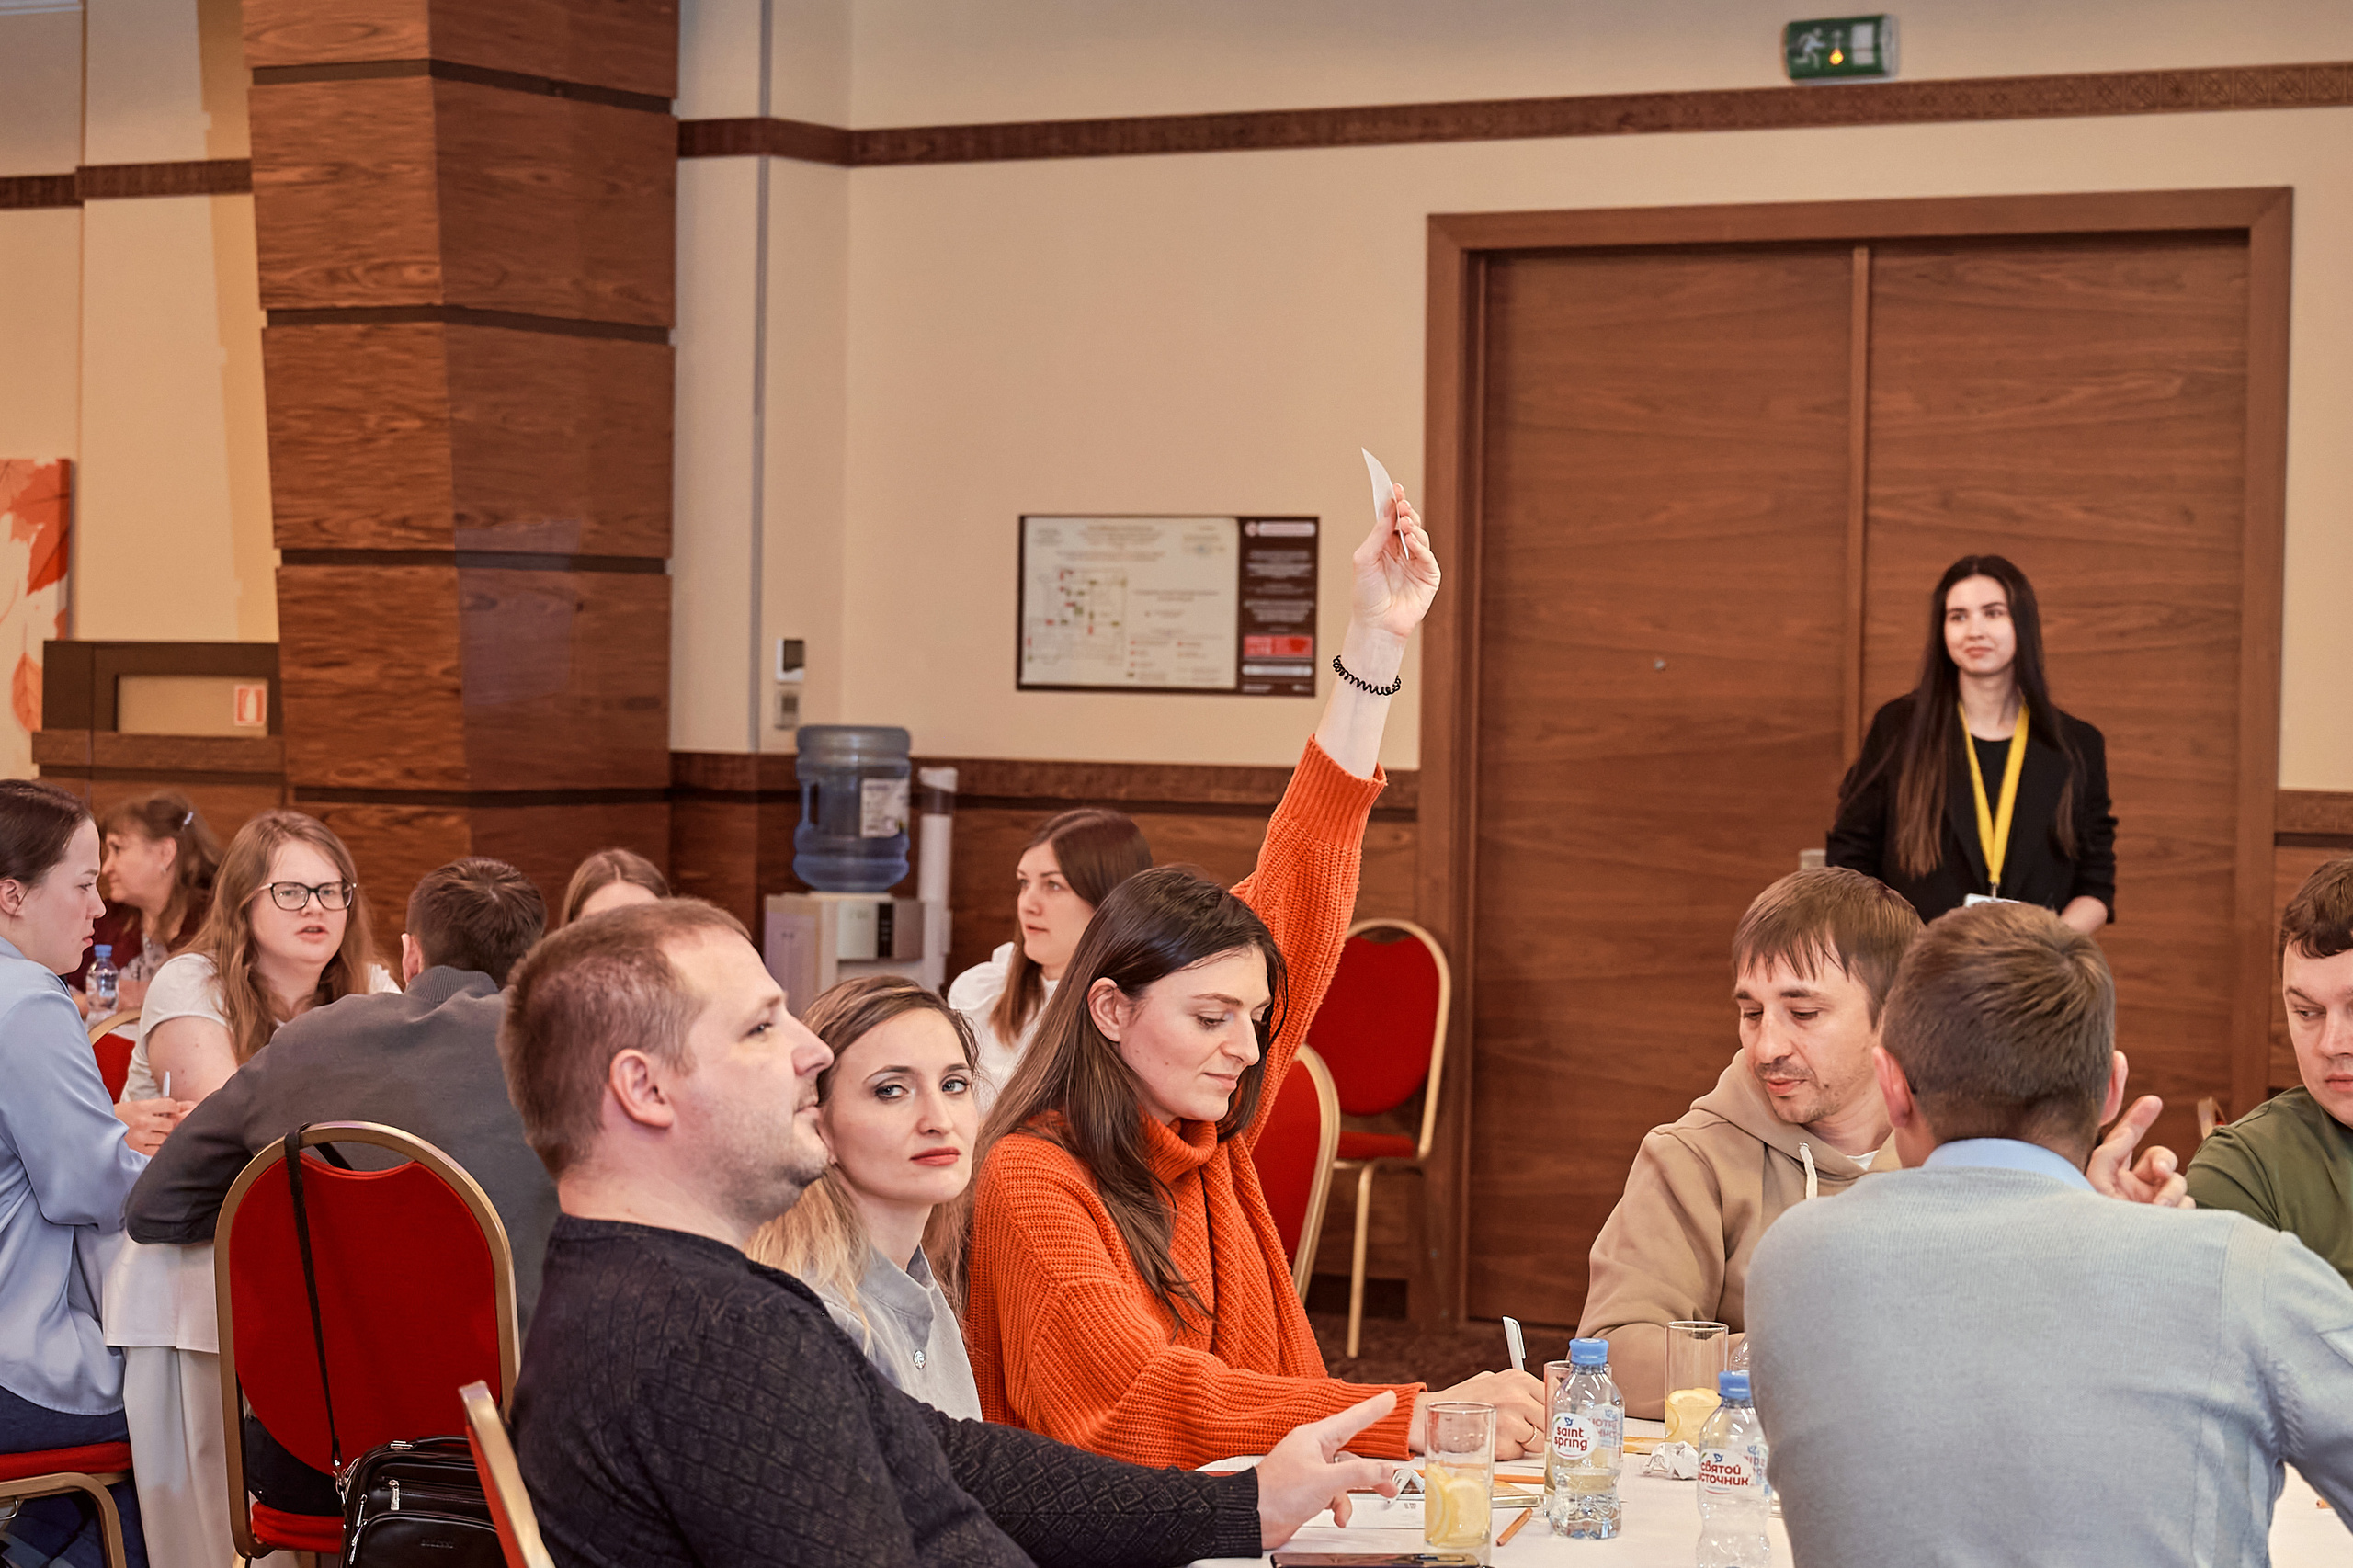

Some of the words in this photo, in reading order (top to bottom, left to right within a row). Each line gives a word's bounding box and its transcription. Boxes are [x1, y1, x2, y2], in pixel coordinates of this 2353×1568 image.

[1556, 1426, 1585, 1438] saint
[1554, 1436, 1588, 1452] spring
[1700, 1460, 1742, 1475] святой
